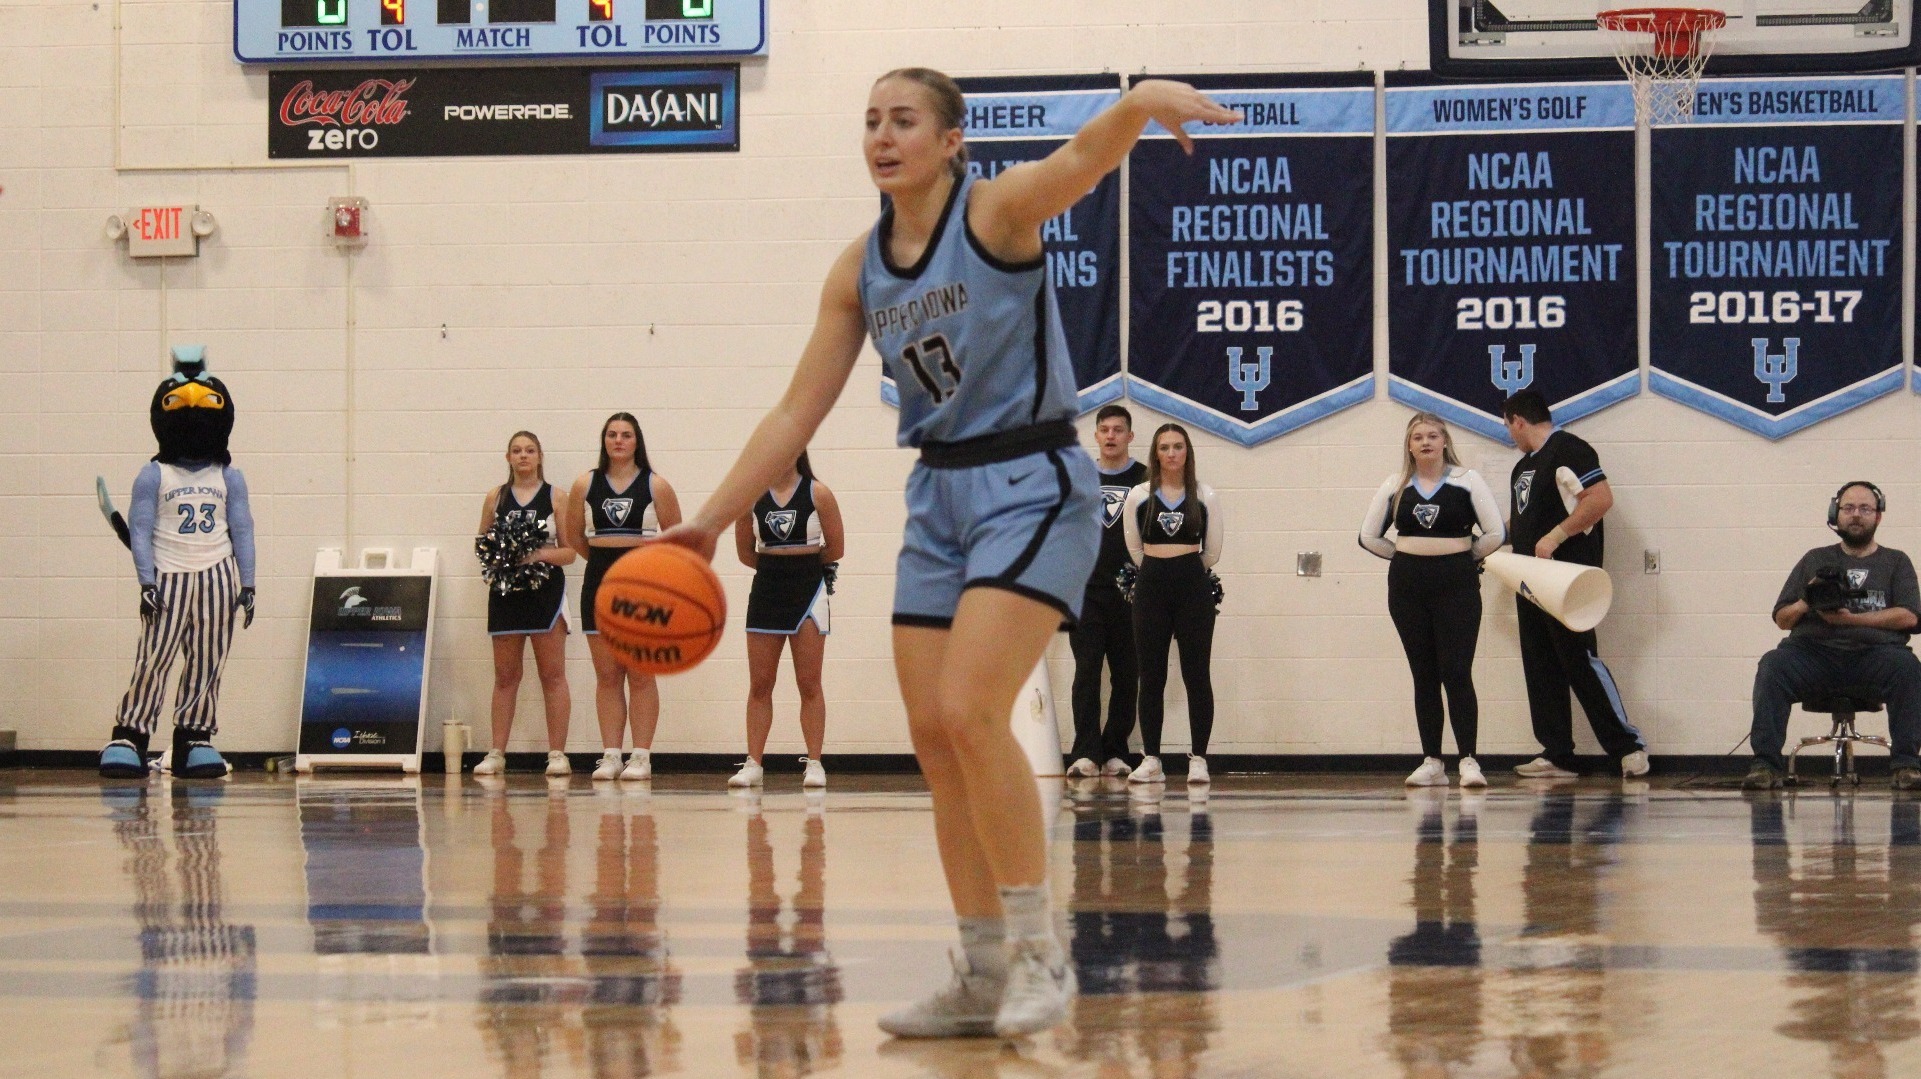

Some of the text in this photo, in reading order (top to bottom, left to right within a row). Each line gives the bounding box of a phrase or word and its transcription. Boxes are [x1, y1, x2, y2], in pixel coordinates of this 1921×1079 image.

[278, 31, 352, 51] POINTS
[367, 29, 417, 51] TOL
[457, 28, 530, 47] MATCH
[576, 24, 627, 47] TOL
[644, 25, 720, 44] POINTS
[280, 77, 416, 127] Coca-Cola
[444, 104, 569, 120] POWERADE
[607, 89, 717, 127] DASANI
[1433, 96, 1587, 123] WOMEN'S GOLF
[1749, 90, 1878, 115] BASKETBALL
[308, 128, 378, 150] zero
[1209, 157, 1292, 194] NCAA
[1468, 151, 1553, 190] NCAA
[1734, 146, 1820, 183] NCAA
[141, 207, 182, 240] EXIT
[1171, 204, 1329, 242] REGIONAL
[1431, 198, 1591, 238] REGIONAL
[1695, 192, 1858, 231] REGIONAL
[1167, 250, 1334, 288] FINALISTS
[1400, 244, 1622, 285] TOURNAMENT
[1663, 239, 1890, 278] TOURNAMENT
[921, 282, 968, 320] IOWA
[1197, 300, 1304, 332] 2016
[1457, 296, 1566, 329] 2016
[1689, 290, 1863, 323] 2016-17
[902, 332, 962, 405] 13
[165, 486, 224, 502] UPPER IOWA
[178, 503, 217, 534] 23
[611, 594, 674, 627] NCAA
